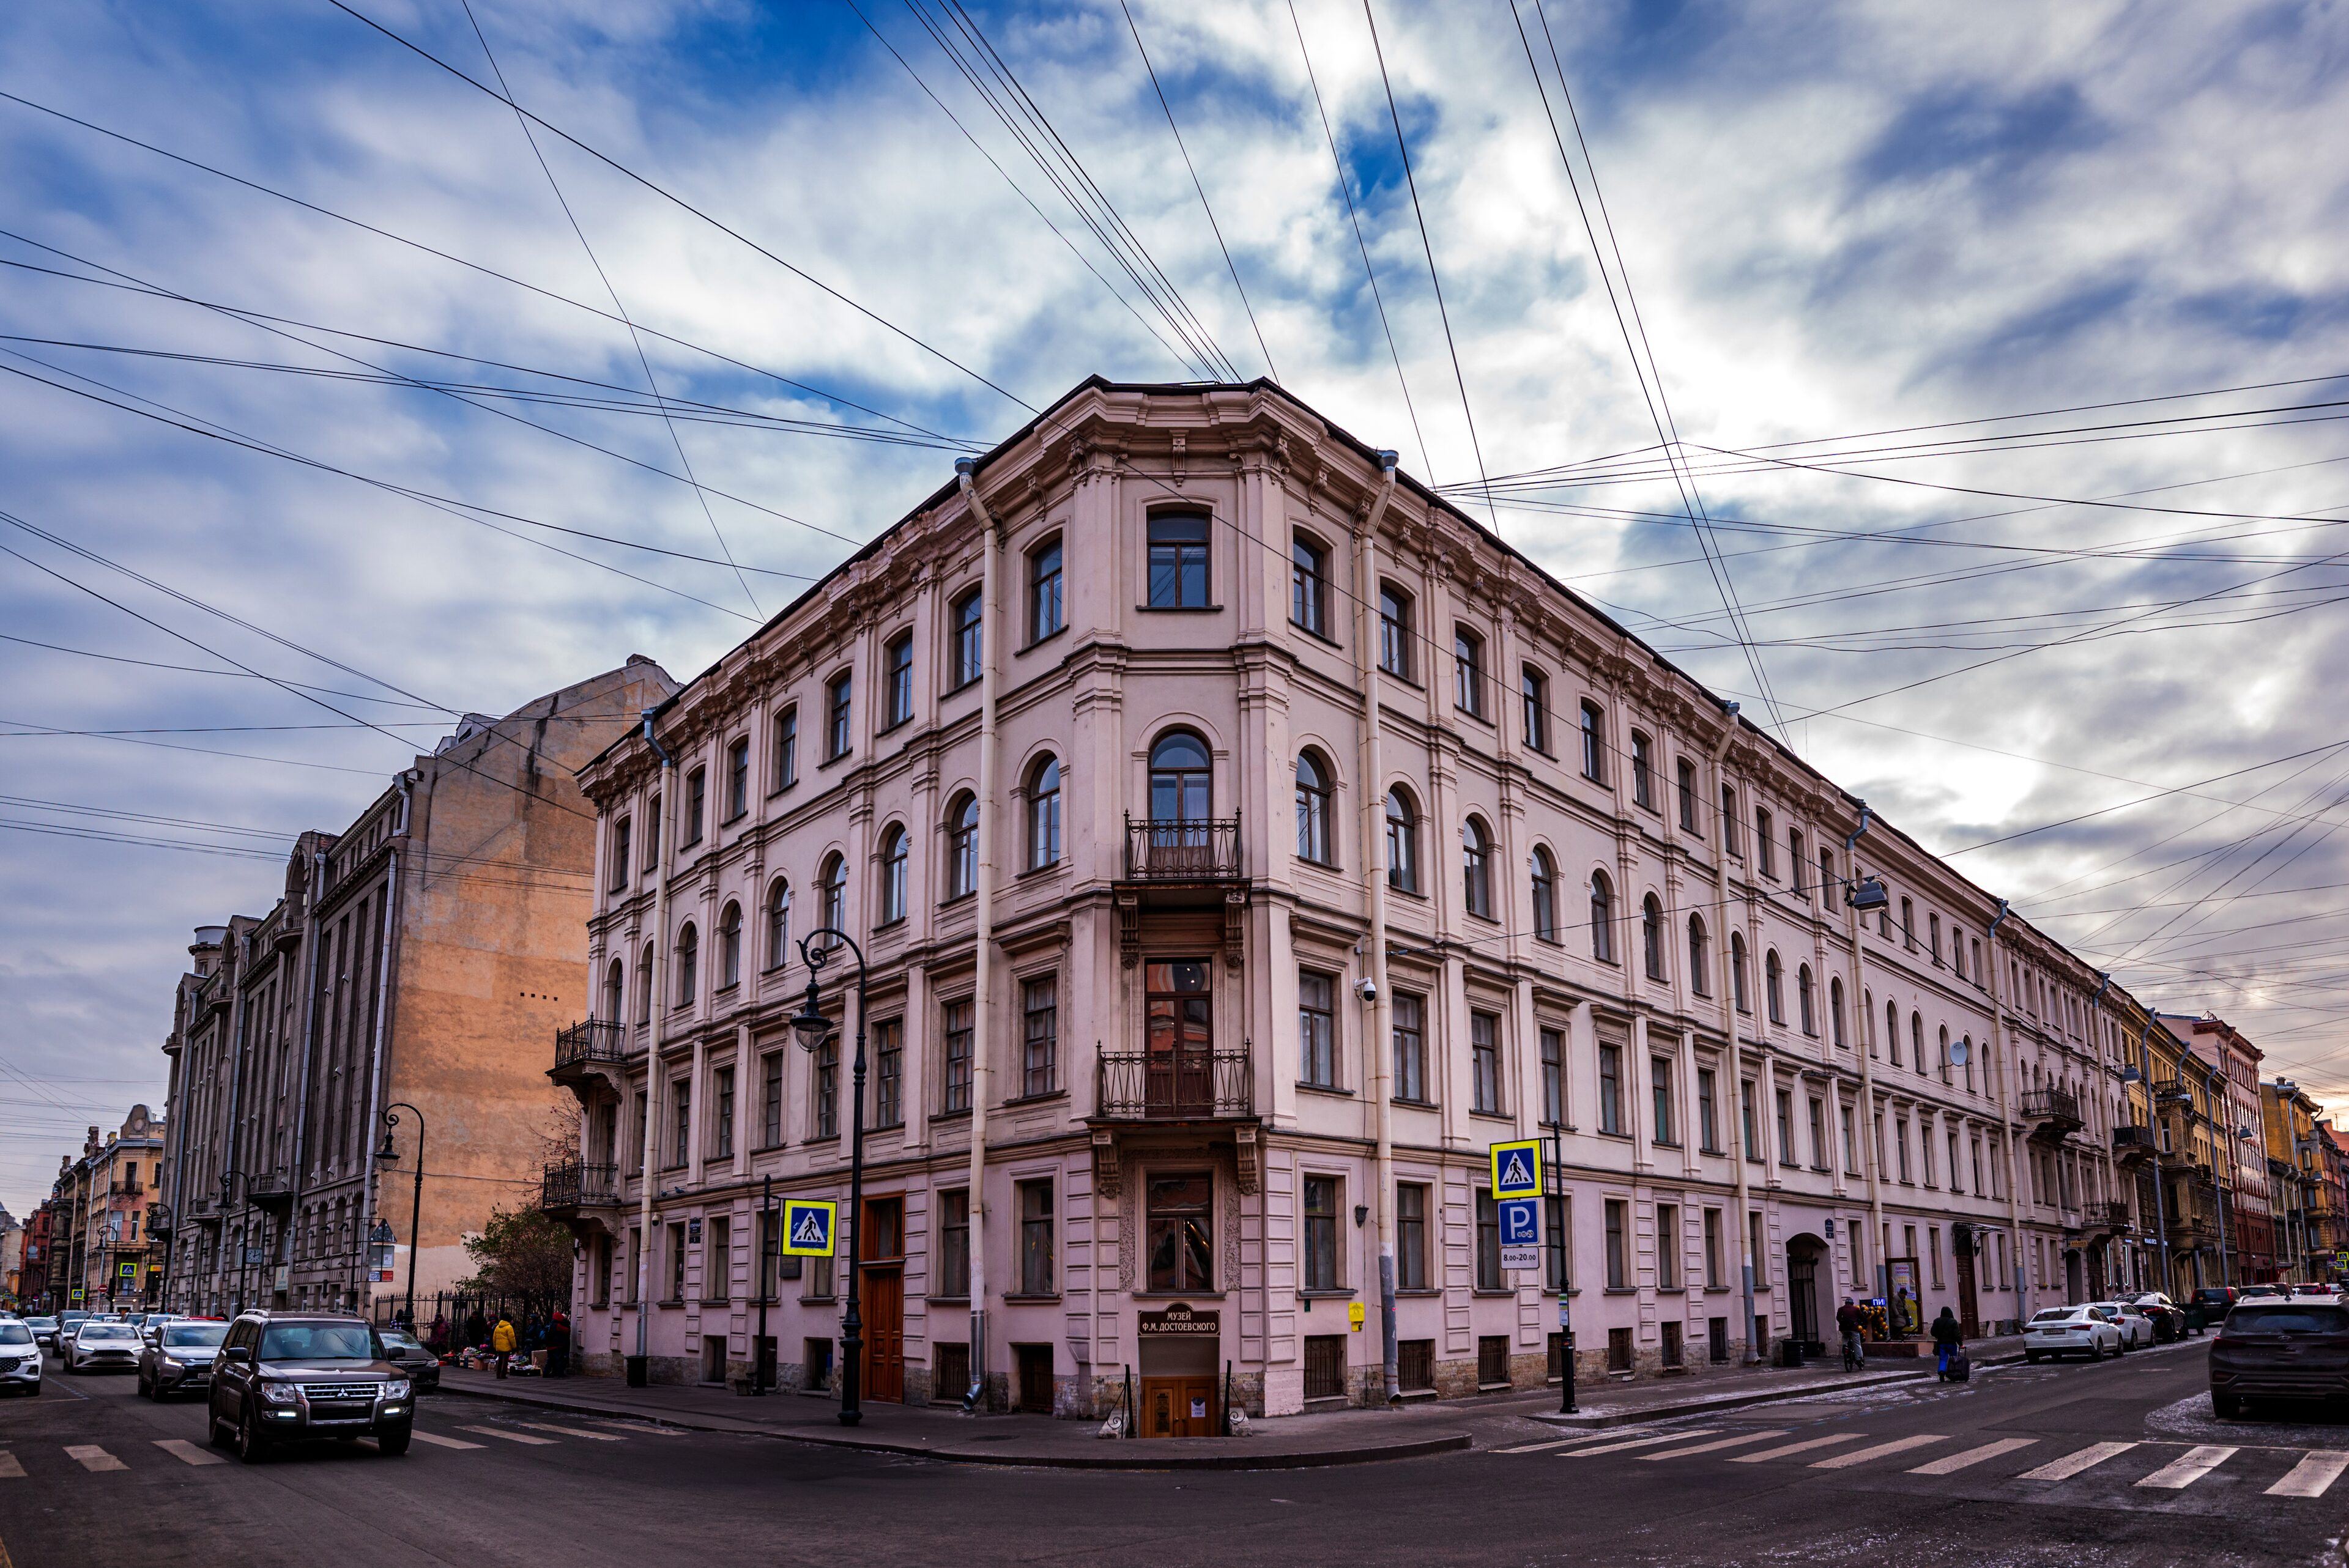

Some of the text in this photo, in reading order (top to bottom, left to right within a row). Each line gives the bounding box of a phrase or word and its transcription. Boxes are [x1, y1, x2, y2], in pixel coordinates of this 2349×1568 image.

[1509, 1206, 1530, 1240] P
[1167, 1311, 1191, 1320] МУЗЕЙ
[1142, 1322, 1215, 1332] Ф.М. ДОСТОЕВСКОГО
